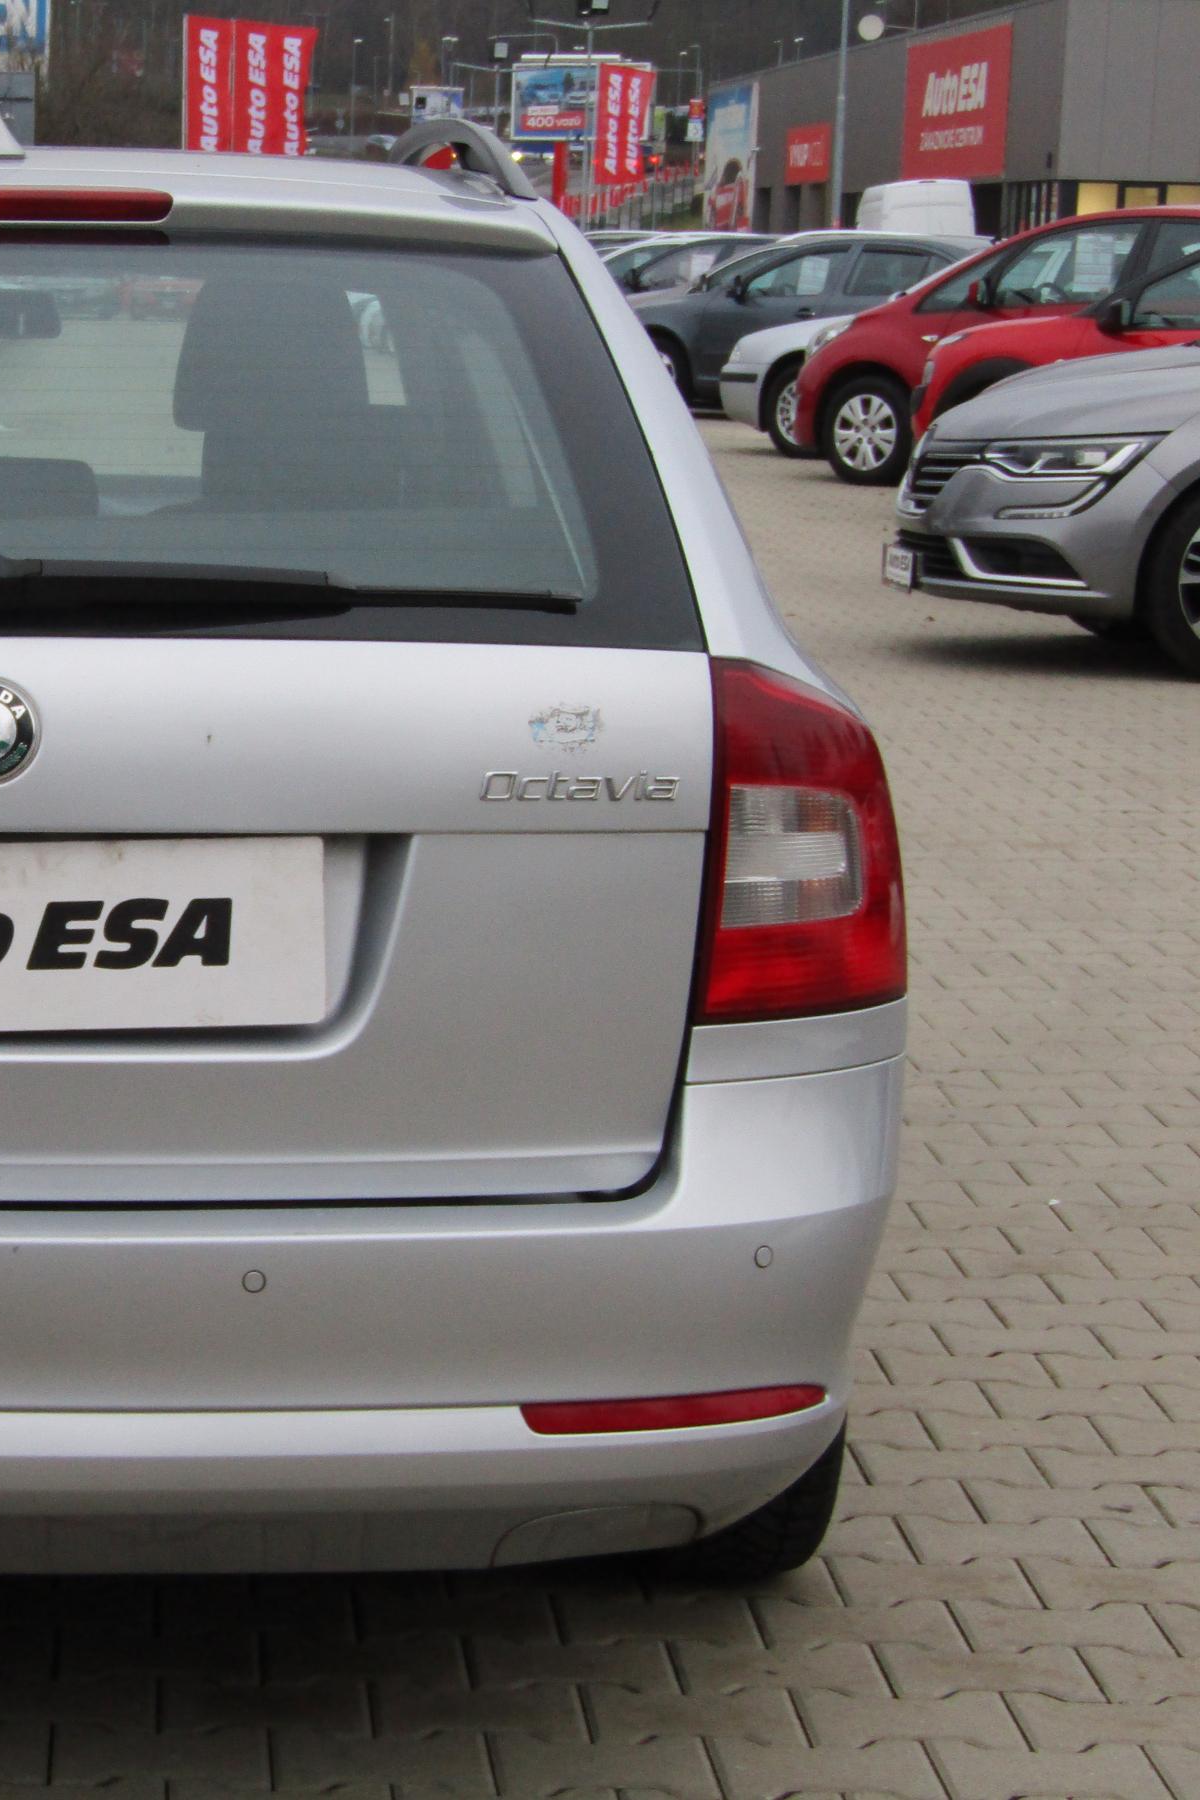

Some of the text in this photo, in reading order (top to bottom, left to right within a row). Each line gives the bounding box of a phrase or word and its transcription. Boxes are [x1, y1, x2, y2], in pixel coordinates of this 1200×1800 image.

[198, 29, 220, 84] ESA
[246, 32, 268, 87] ESA
[283, 37, 303, 90] ESA
[607, 73, 624, 116] ESA
[628, 77, 641, 117] ESA
[921, 62, 989, 118] Auto ESA
[526, 116, 554, 127] 400
[479, 769, 681, 802] Octavia
[26, 897, 233, 971] ESA
